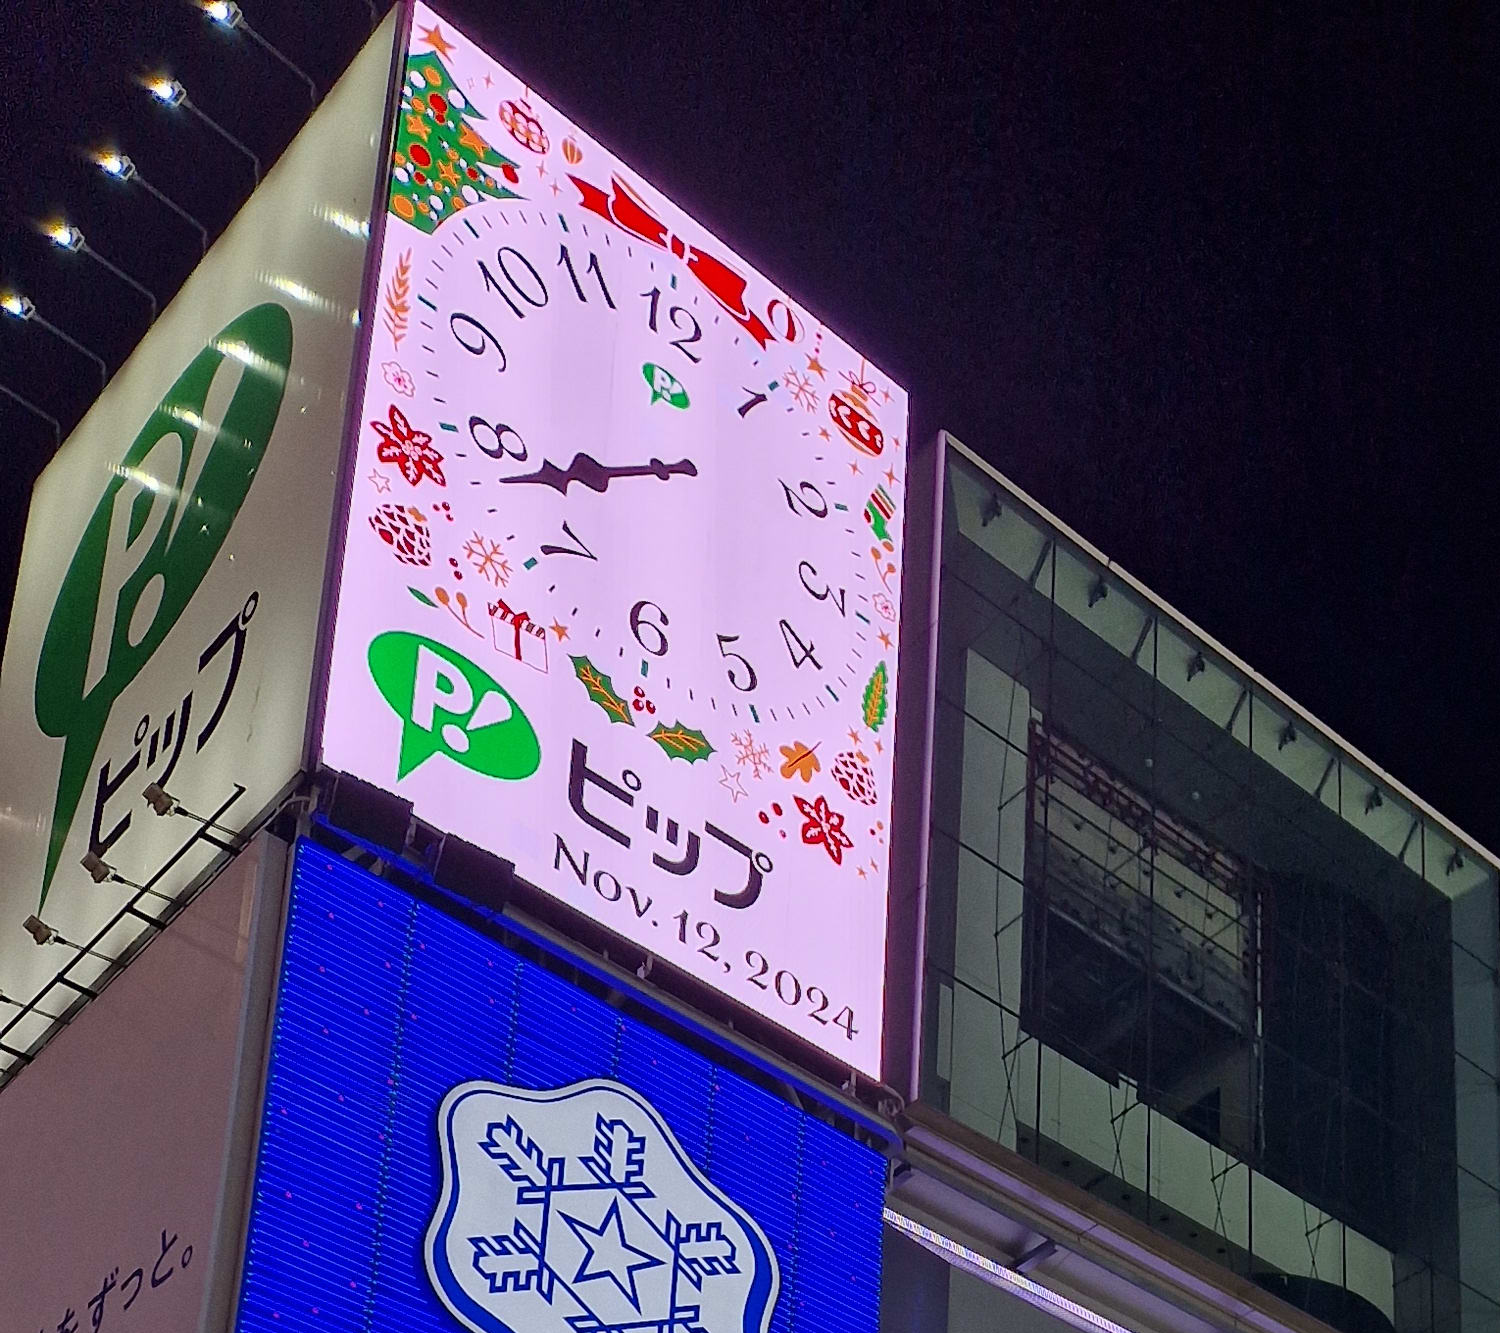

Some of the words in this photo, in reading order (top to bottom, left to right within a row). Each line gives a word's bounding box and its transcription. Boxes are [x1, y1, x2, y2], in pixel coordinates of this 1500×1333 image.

[478, 247, 549, 318] 10
[557, 244, 616, 310] 11
[450, 313, 507, 372] 9
[641, 287, 701, 363] 12
[738, 388, 767, 418] 1
[470, 416, 527, 461] 8
[779, 479, 827, 518] 2
[541, 522, 597, 560] 7
[799, 561, 845, 617] 3
[630, 601, 668, 656] 6
[780, 619, 822, 671] 4
[717, 635, 757, 692] 5
[88, 591, 260, 859] ピップ
[569, 738, 772, 909] ピップ
[674, 910, 733, 975] 12,
[744, 950, 860, 1041] 2024
